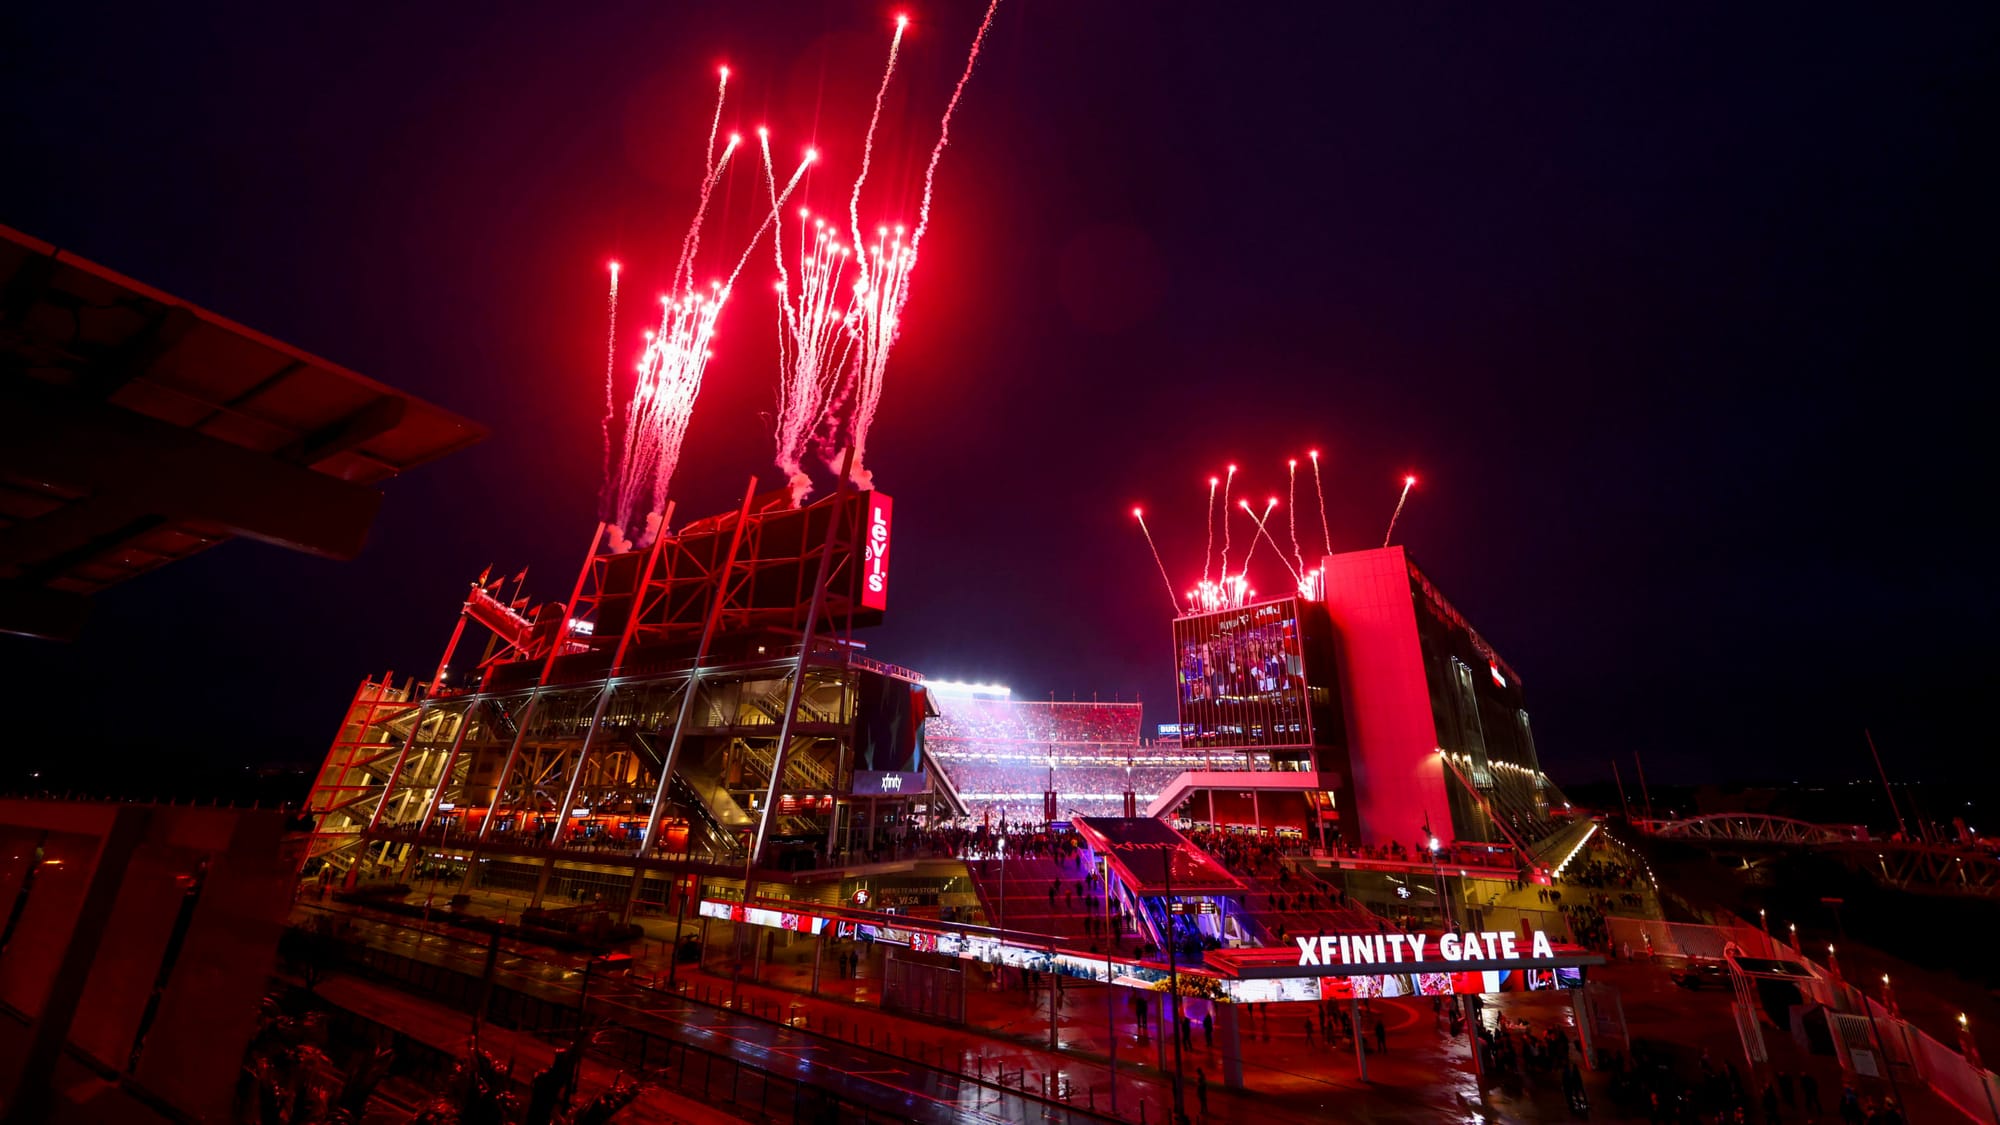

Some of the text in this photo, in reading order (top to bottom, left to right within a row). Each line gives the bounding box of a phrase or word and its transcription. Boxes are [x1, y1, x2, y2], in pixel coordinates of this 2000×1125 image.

[881, 772, 903, 793] xfinity
[919, 887, 940, 895] STORE
[899, 896, 919, 905] VISA
[1296, 930, 1554, 966] XFINITY GATE A
